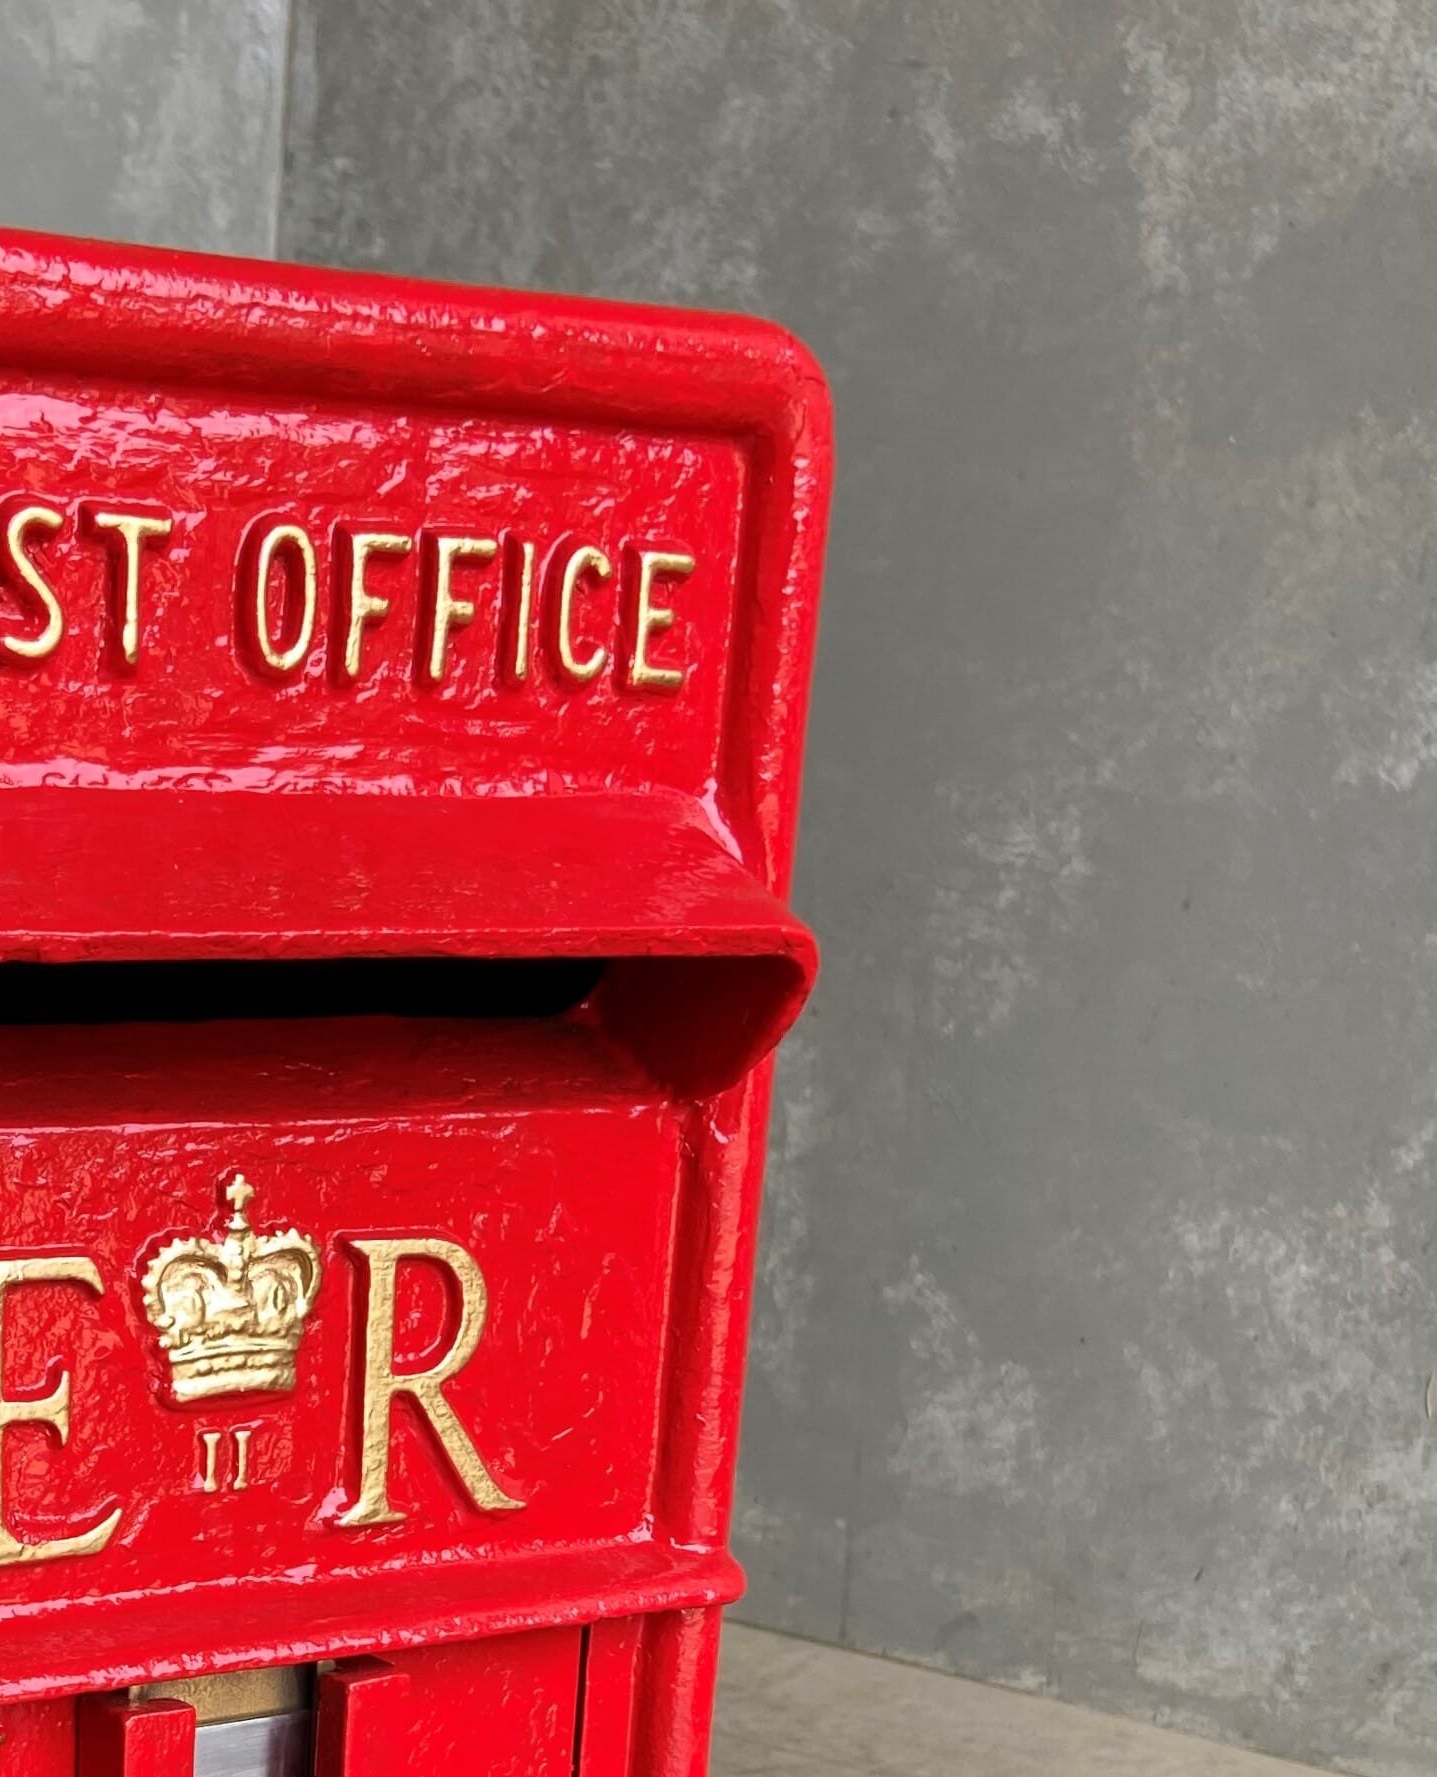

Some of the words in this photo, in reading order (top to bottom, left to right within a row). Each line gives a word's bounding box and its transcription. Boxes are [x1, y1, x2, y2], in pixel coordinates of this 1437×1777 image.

[257, 523, 696, 688] OFFICE
[201, 1430, 252, 1493] II
[338, 1238, 527, 1528] R
